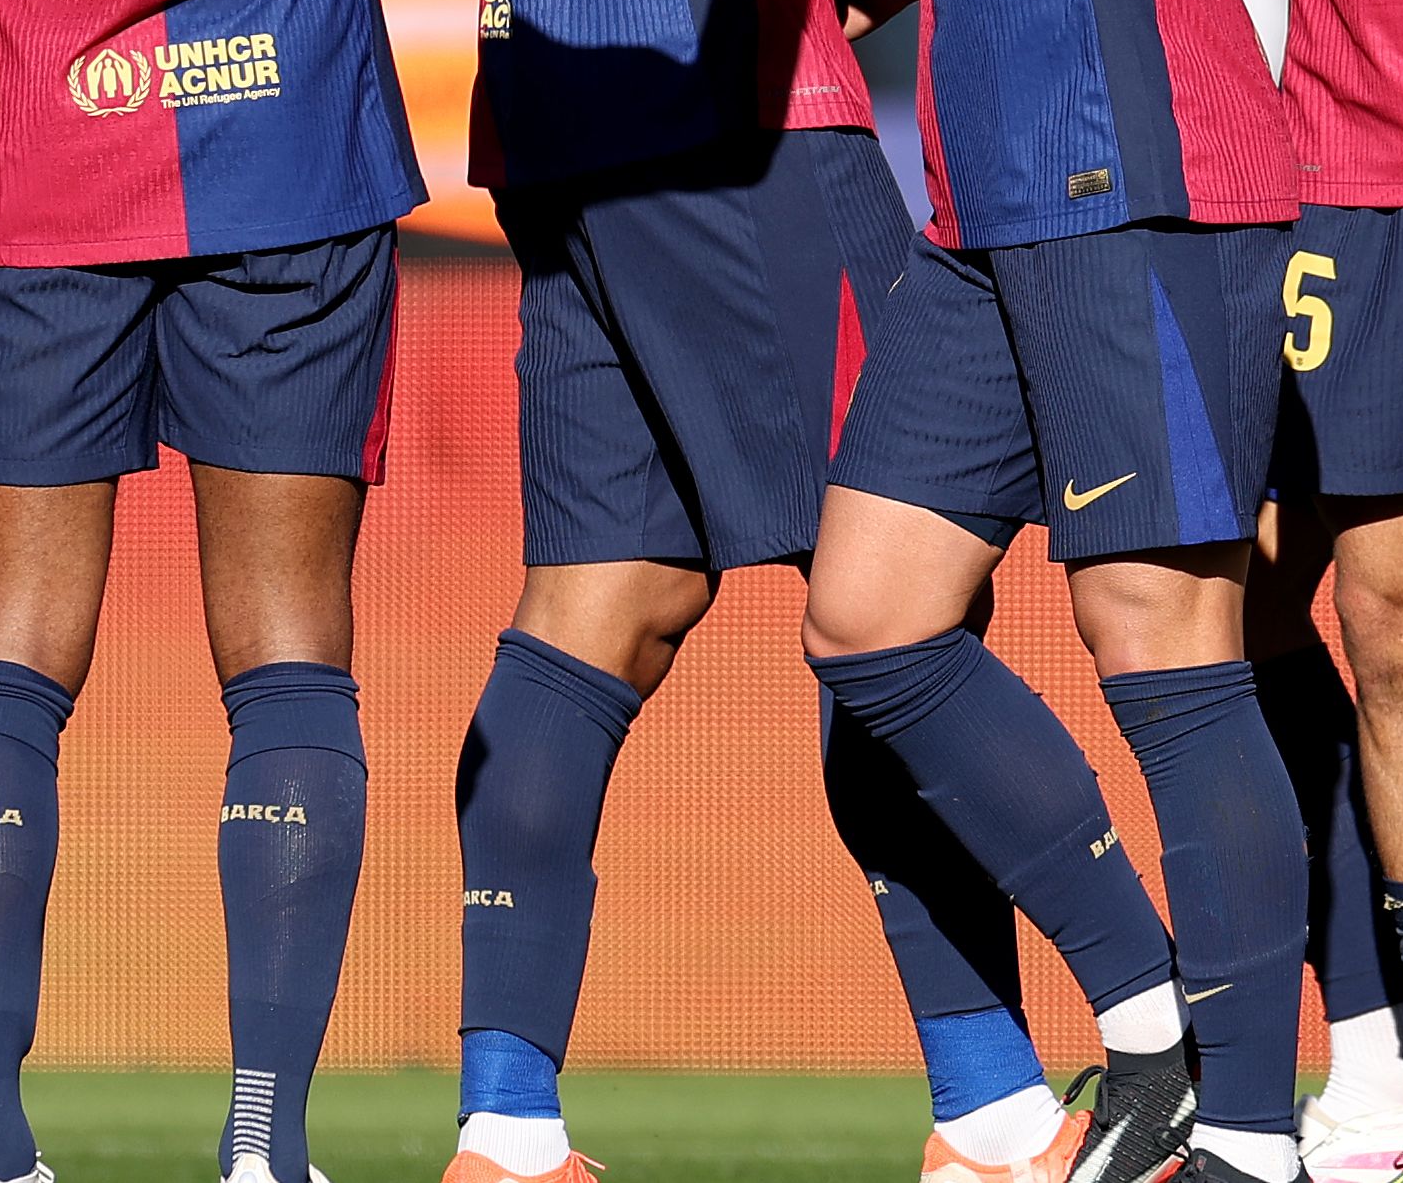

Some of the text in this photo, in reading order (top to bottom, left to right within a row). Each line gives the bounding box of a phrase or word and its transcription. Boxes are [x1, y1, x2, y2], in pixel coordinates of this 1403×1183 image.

[154, 33, 277, 71] UNHCR
[159, 59, 280, 98] ACNUR
[161, 86, 281, 109] The UN Refugee Agency
[220, 804, 307, 826] BARÇA
[463, 889, 514, 908] ARÇA
